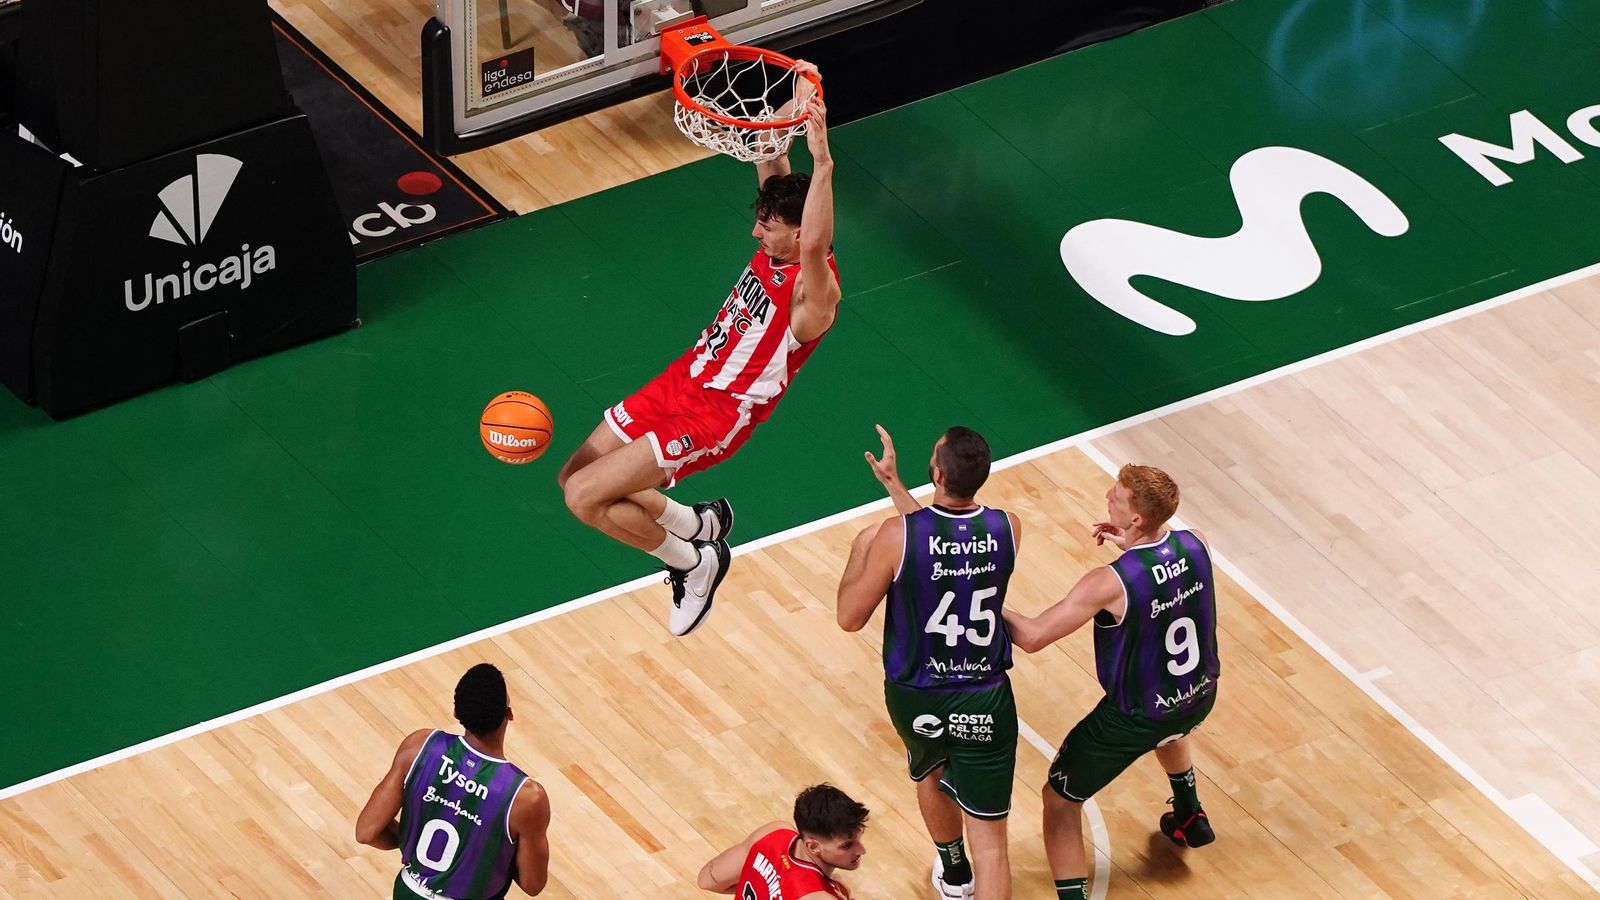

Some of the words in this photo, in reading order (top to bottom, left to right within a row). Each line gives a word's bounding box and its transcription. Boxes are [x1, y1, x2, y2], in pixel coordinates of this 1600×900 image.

[484, 68, 506, 82] liga
[484, 71, 532, 92] endesa
[348, 201, 437, 245] cb
[124, 243, 276, 312] Unicaja
[736, 265, 772, 326] RONA
[707, 322, 729, 360] 22
[489, 430, 537, 448] Wilson
[928, 533, 998, 555] Kravish
[1151, 557, 1189, 585] Díaz
[925, 587, 997, 646] 45
[1165, 617, 1199, 675] 9
[948, 713, 994, 725] COSTA
[971, 725, 994, 734] SOL
[438, 754, 489, 800] Tyson
[416, 818, 460, 872] 0
